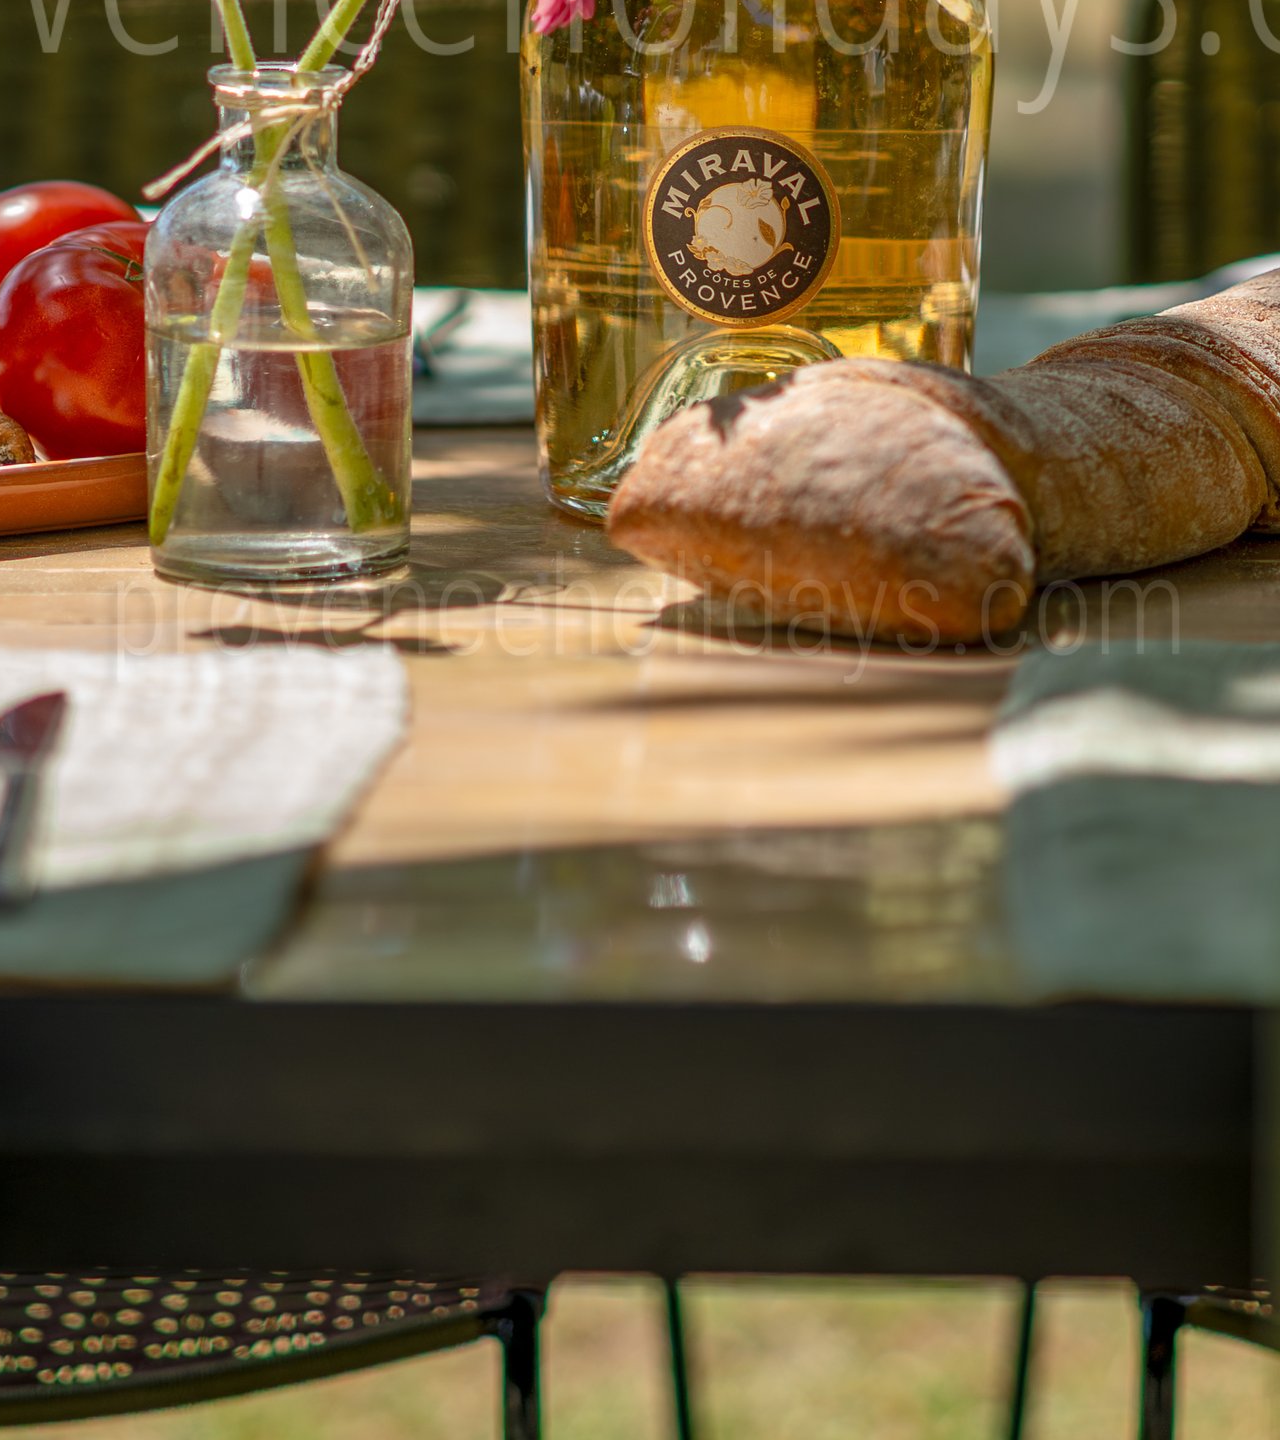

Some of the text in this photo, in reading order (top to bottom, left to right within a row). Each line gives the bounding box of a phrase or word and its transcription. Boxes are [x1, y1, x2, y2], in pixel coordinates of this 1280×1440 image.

[661, 149, 821, 225] MIRAVAL
[668, 250, 813, 311] PROVENCE
[703, 268, 777, 288] CÔTES DE
